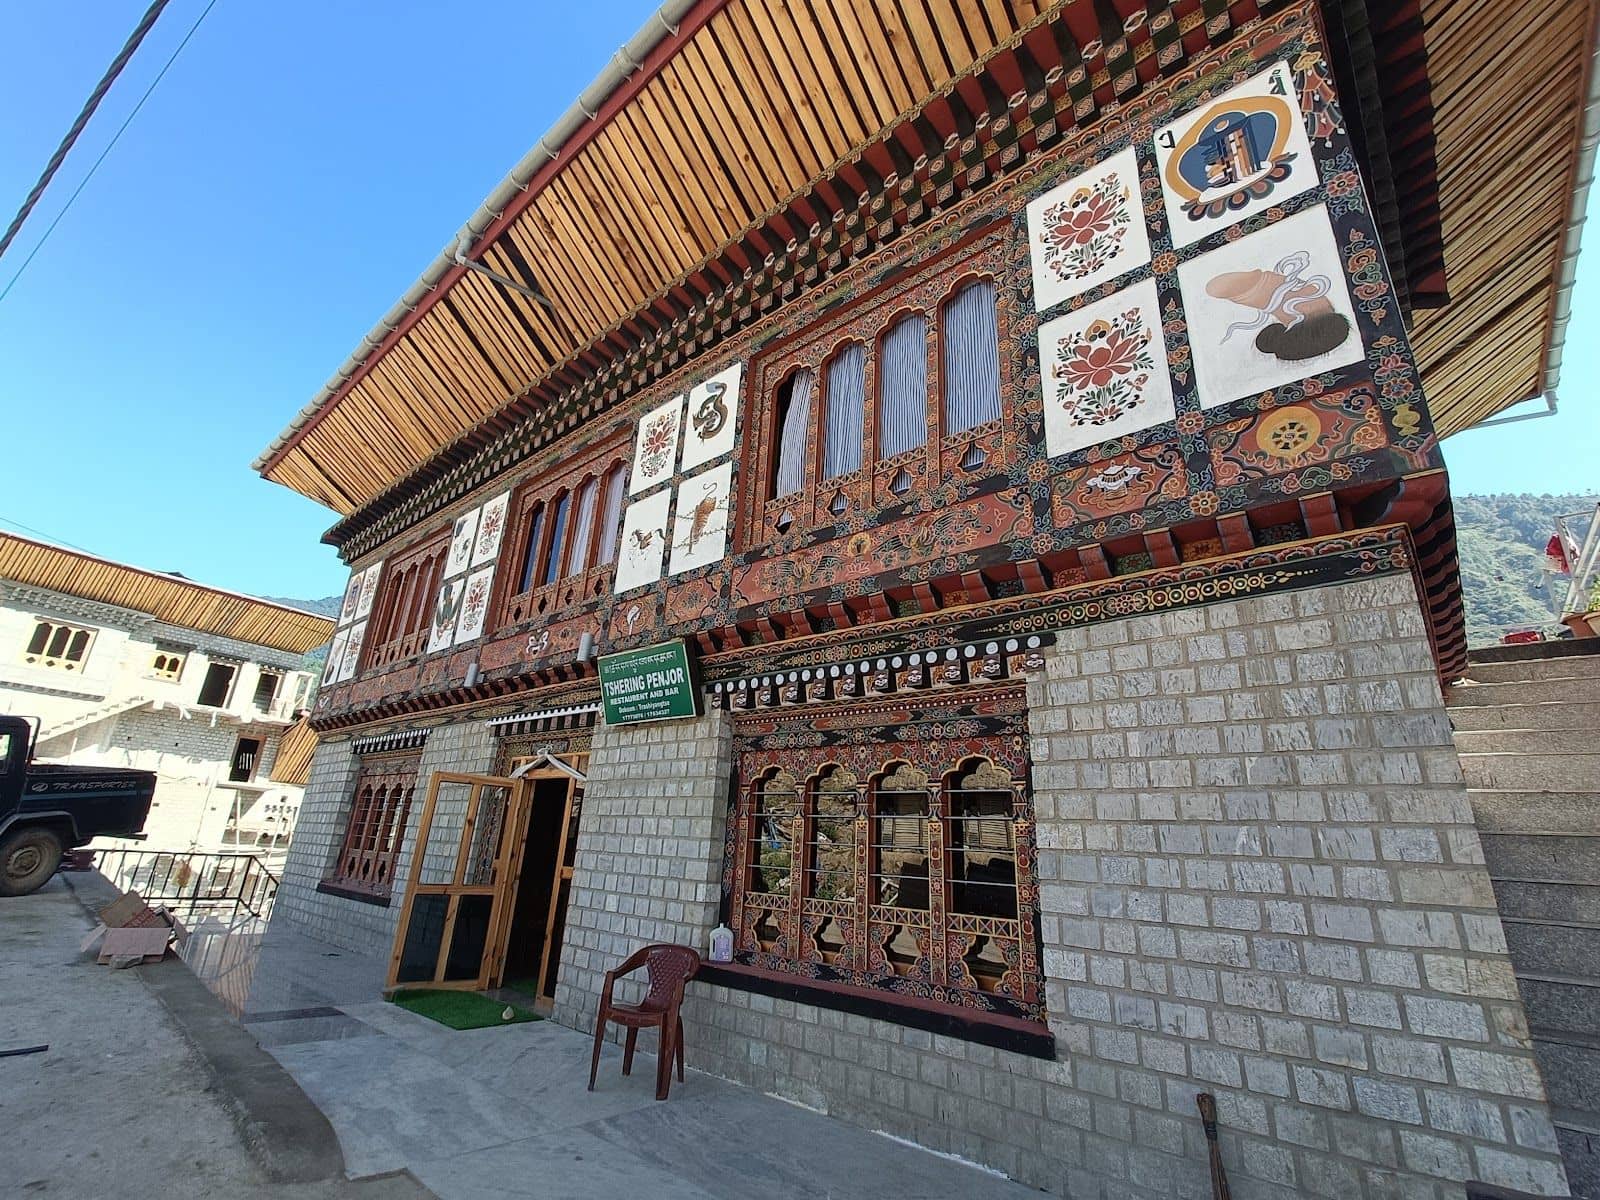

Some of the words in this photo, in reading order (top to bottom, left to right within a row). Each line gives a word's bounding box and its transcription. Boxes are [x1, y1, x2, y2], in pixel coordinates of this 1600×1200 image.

[604, 675, 645, 696] TSHERING
[646, 667, 684, 689] PENJOR
[650, 690, 663, 698] AND
[664, 687, 679, 696] BAR
[52, 780, 136, 791] TRANSPORTER
